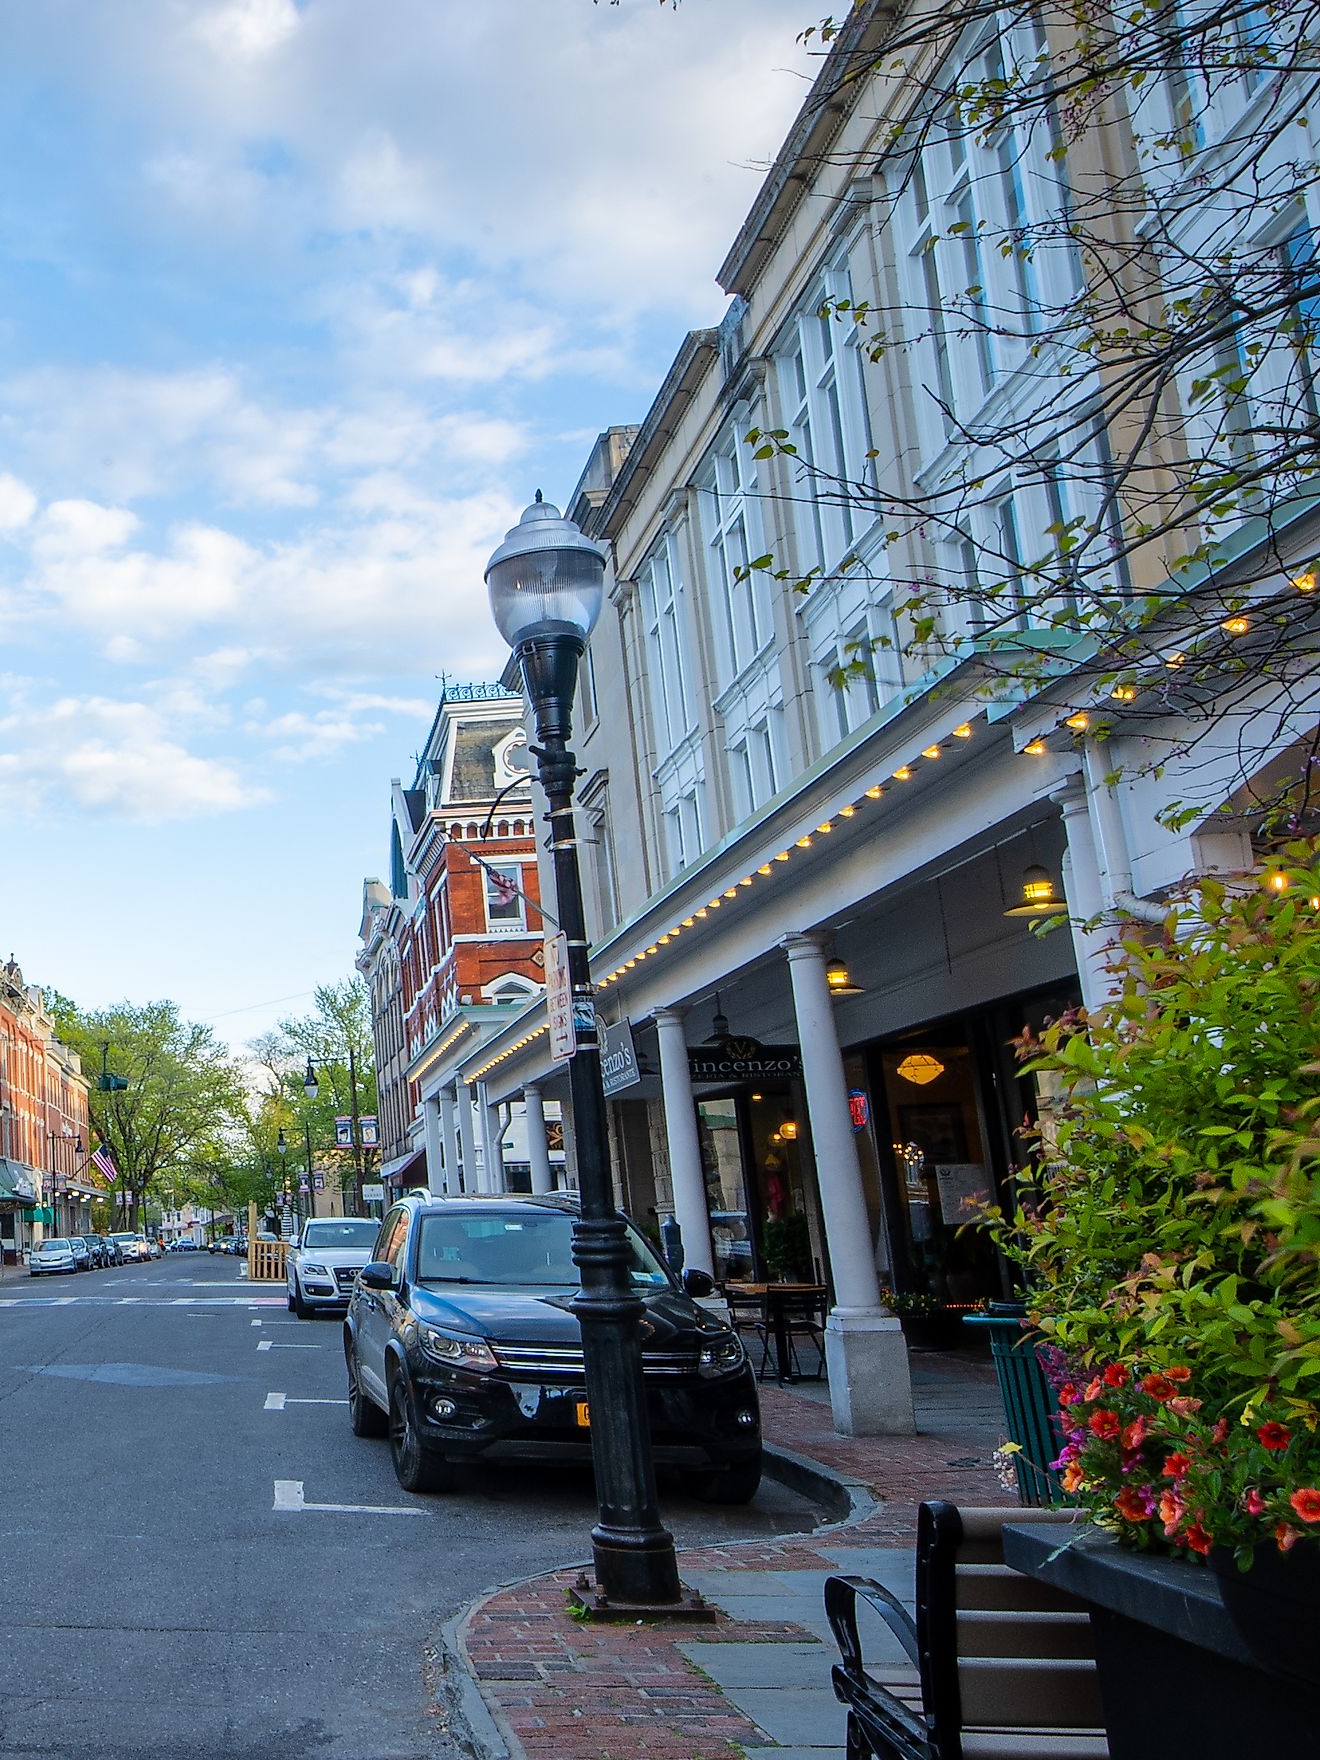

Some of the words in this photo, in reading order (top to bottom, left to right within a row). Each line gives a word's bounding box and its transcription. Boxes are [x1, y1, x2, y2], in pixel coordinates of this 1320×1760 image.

[549, 992, 568, 1012] BETWEEN
[553, 1012, 567, 1030] SIGNS
[600, 1042, 631, 1078] cenzo's
[741, 1070, 801, 1079] RISTORAN
